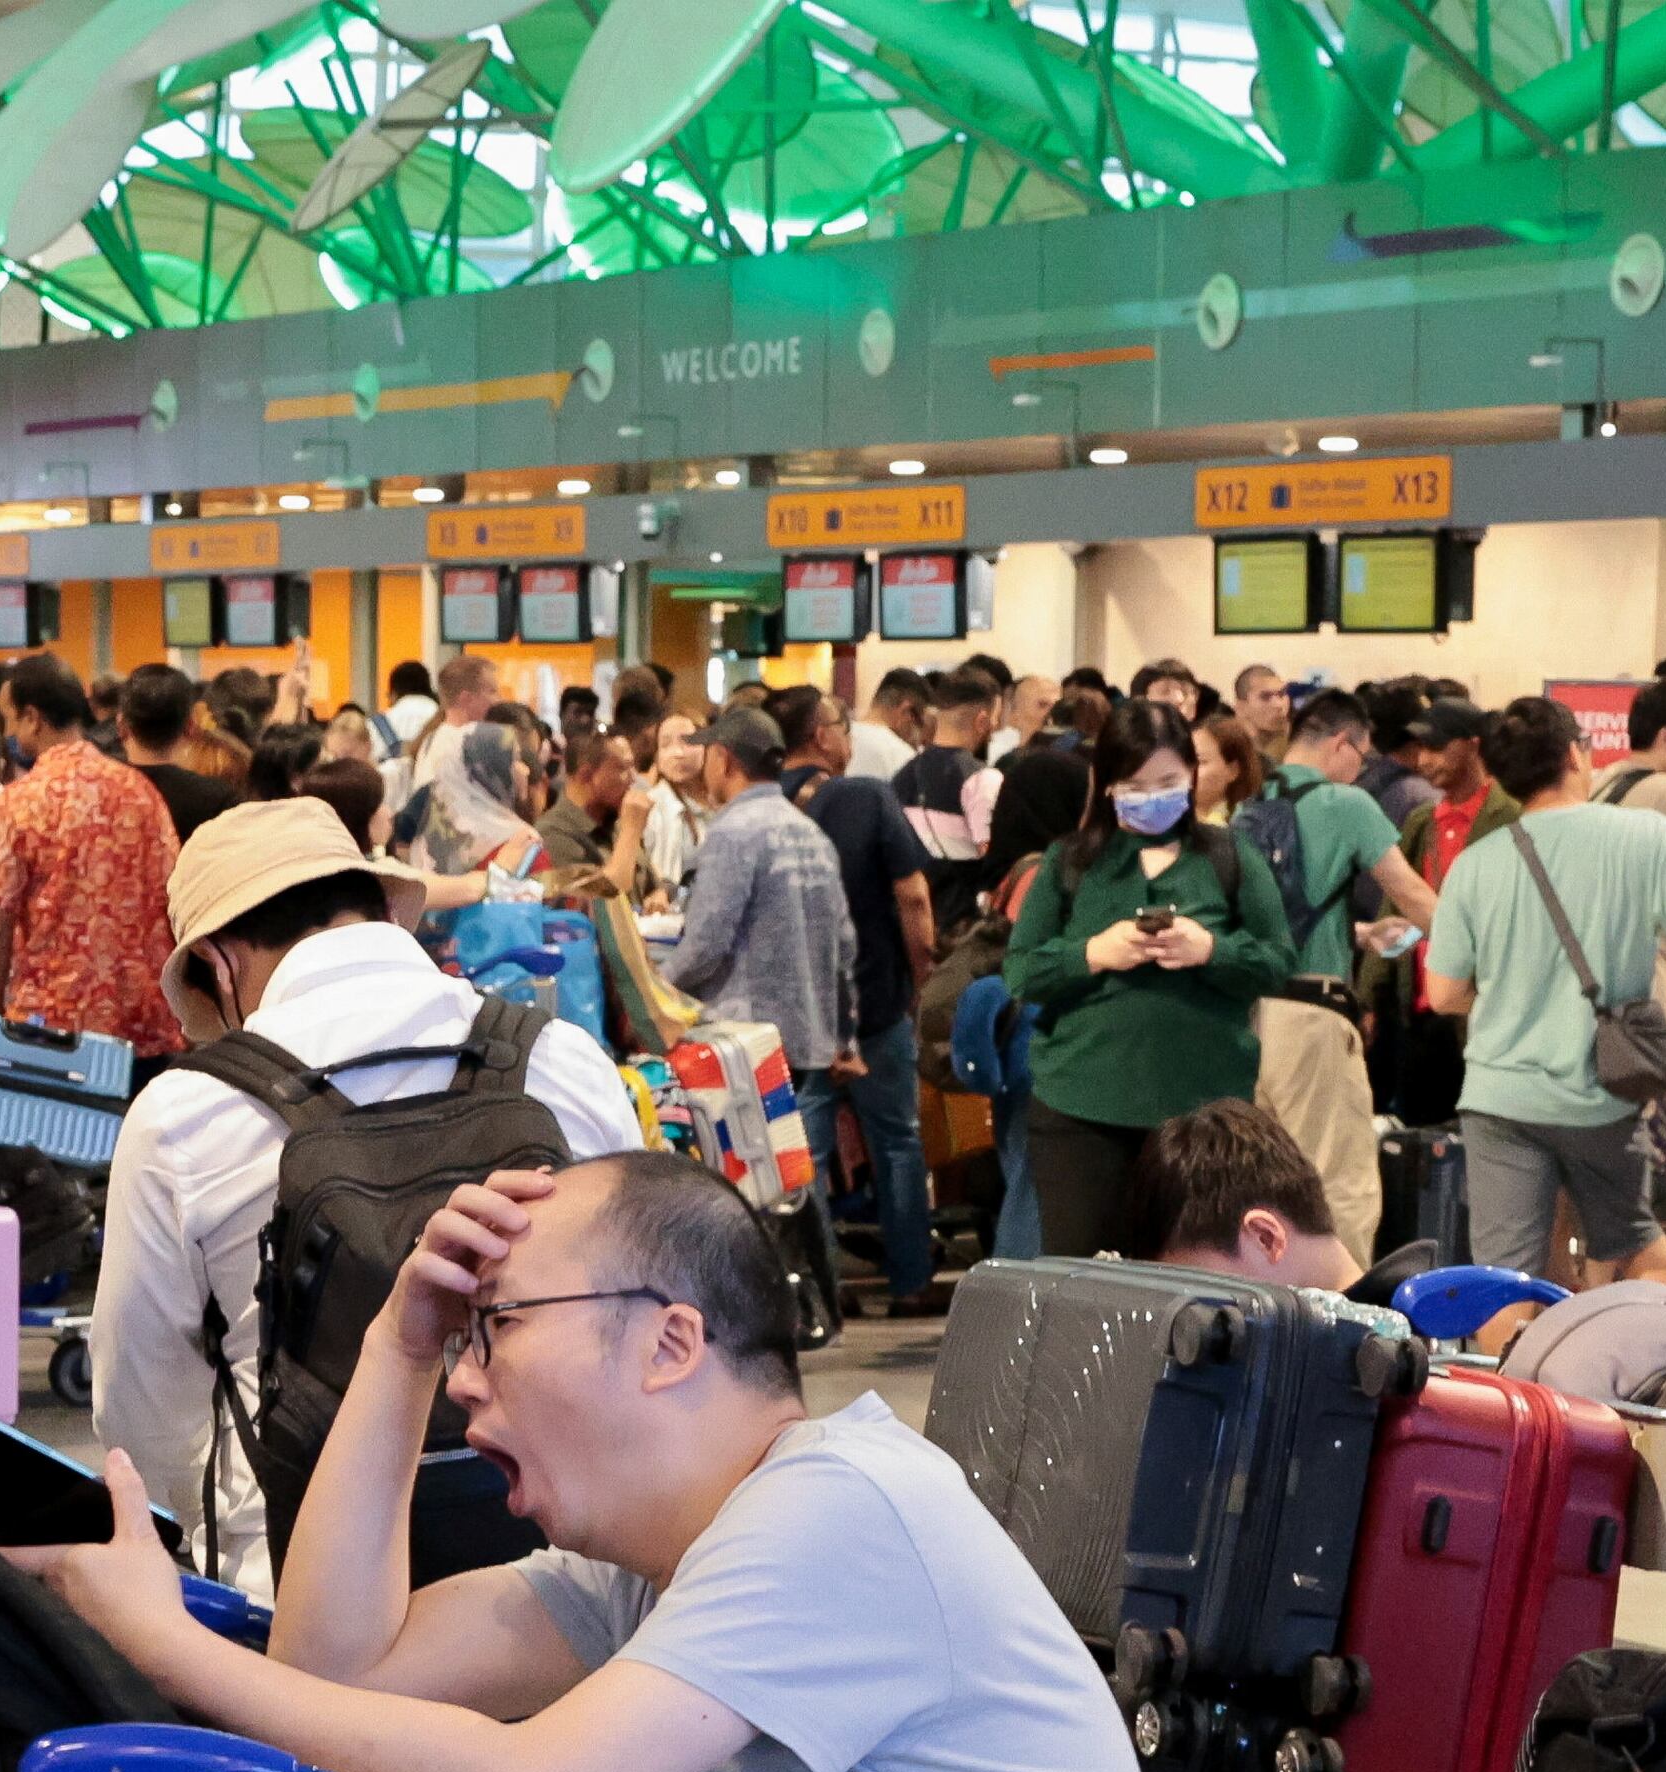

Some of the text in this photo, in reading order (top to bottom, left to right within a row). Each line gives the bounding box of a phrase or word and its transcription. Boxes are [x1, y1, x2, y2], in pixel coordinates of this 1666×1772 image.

[660, 336, 803, 385] WELCOME
[1206, 481, 1249, 513] X12
[1392, 469, 1439, 504] X13
[918, 499, 955, 529] X11
